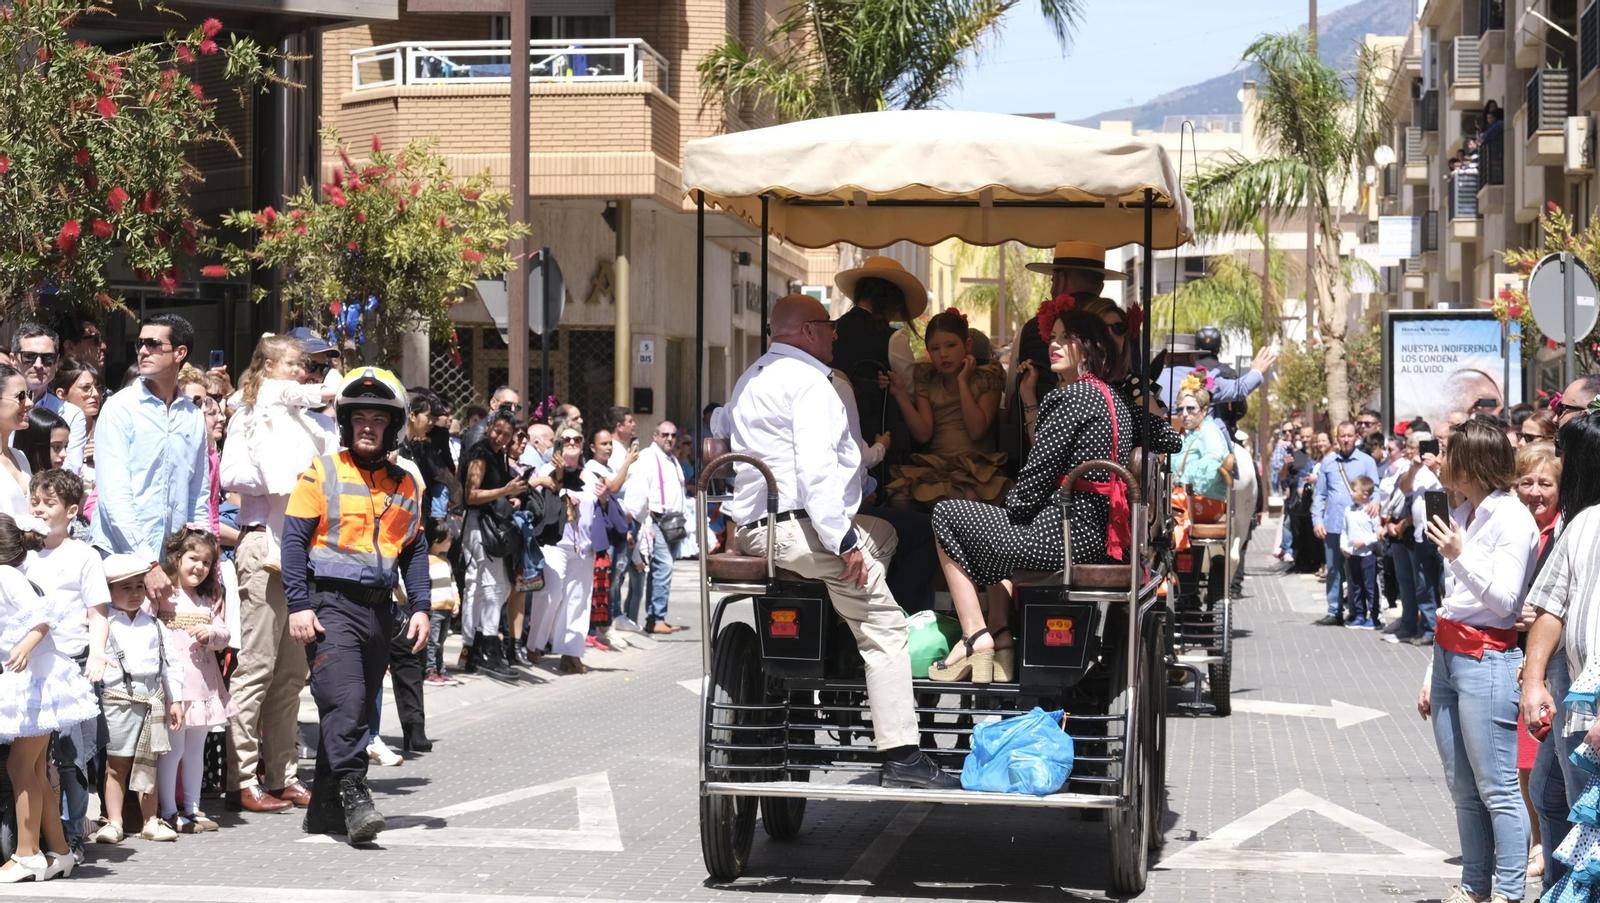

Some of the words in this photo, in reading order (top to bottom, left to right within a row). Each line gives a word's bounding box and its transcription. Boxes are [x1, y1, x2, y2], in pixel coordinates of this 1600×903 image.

[1401, 344, 1439, 353] NUESTRA
[1441, 344, 1498, 353] INDIFERENCIA
[1401, 354, 1417, 363] LOS
[1418, 354, 1459, 363] CONDENA
[1401, 365, 1411, 373] AL
[1413, 365, 1444, 373] OLVIDO
